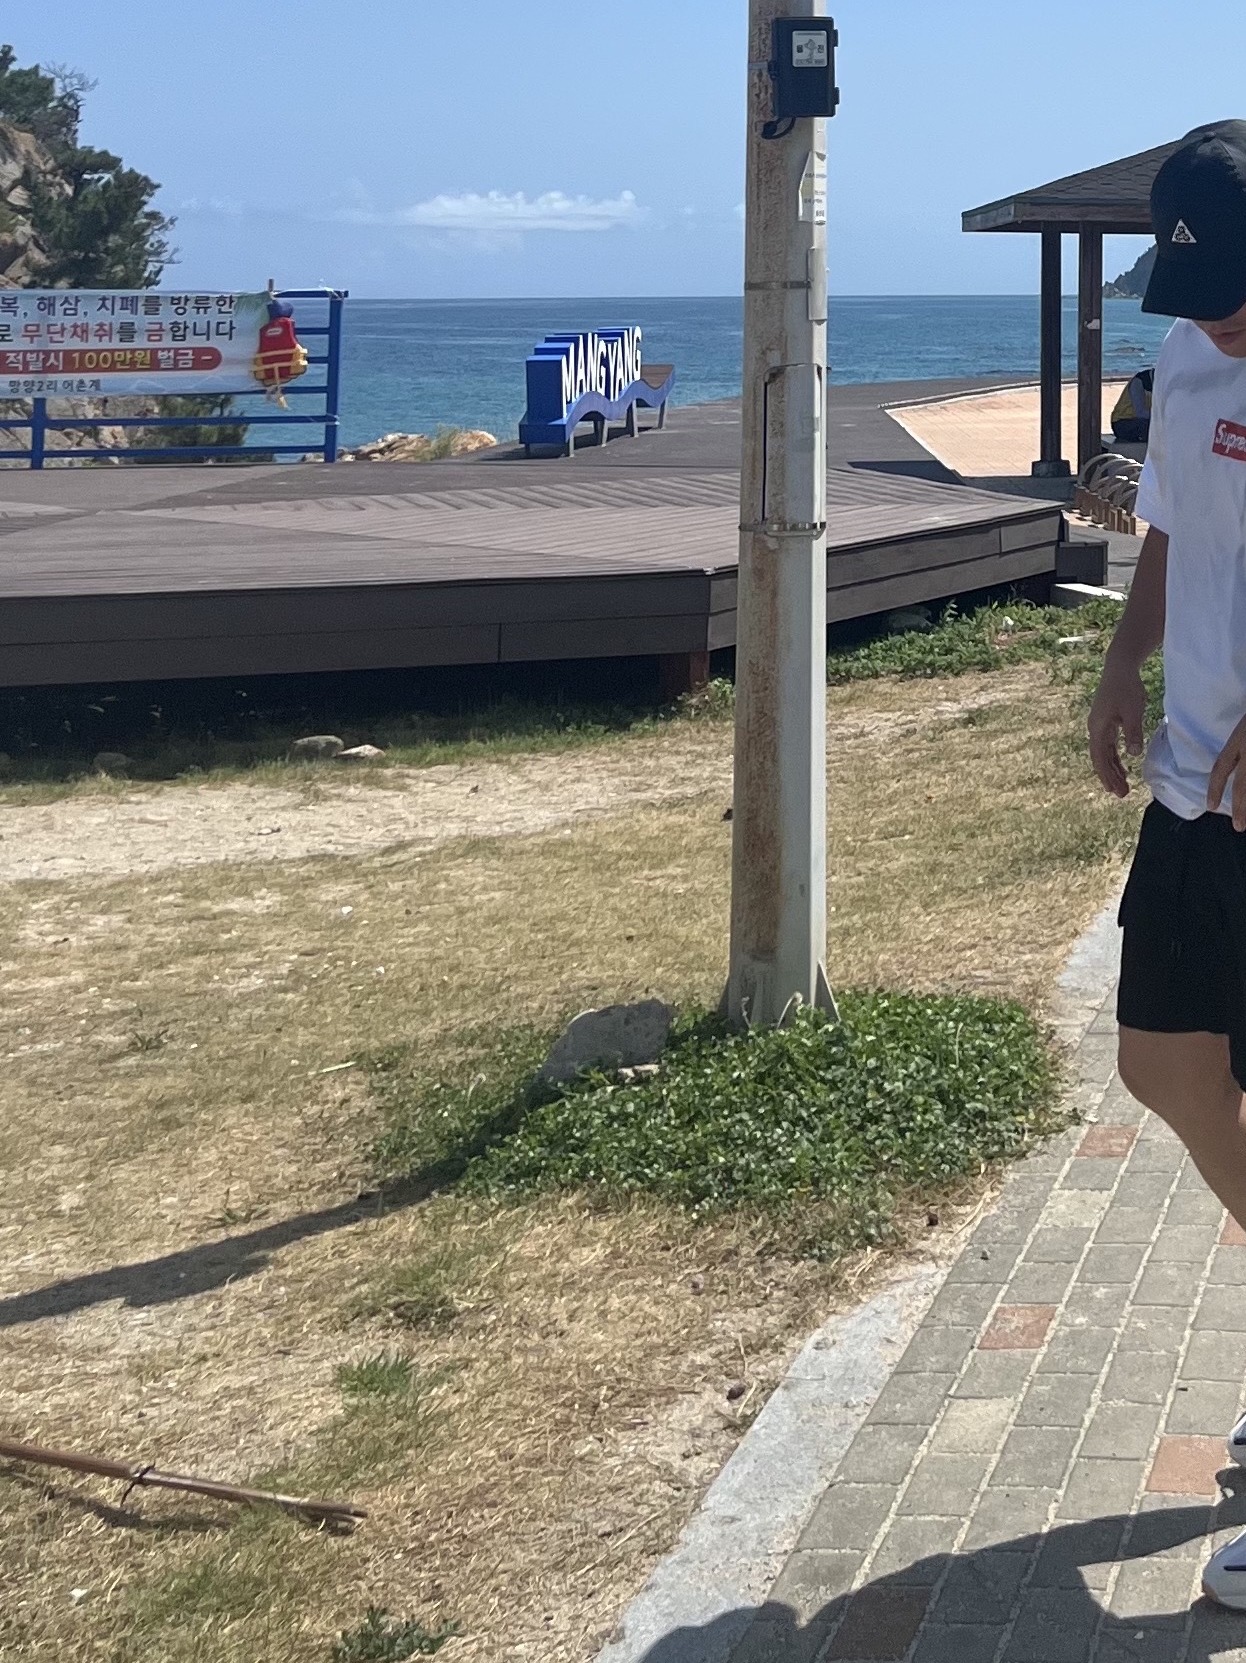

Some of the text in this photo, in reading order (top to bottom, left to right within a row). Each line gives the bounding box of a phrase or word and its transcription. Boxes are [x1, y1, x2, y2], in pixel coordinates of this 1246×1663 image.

[36, 295, 88, 318] 해삼,
[170, 294, 235, 316] 방류한
[22, 321, 138, 344] 무단채취를
[144, 319, 236, 343] 금합니다
[5, 351, 63, 371] 적발시
[71, 350, 151, 370] 100만원
[157, 349, 195, 368] 벌금
[561, 325, 642, 419] MANGYANG
[9, 378, 101, 394] 망양2리 어촌계
